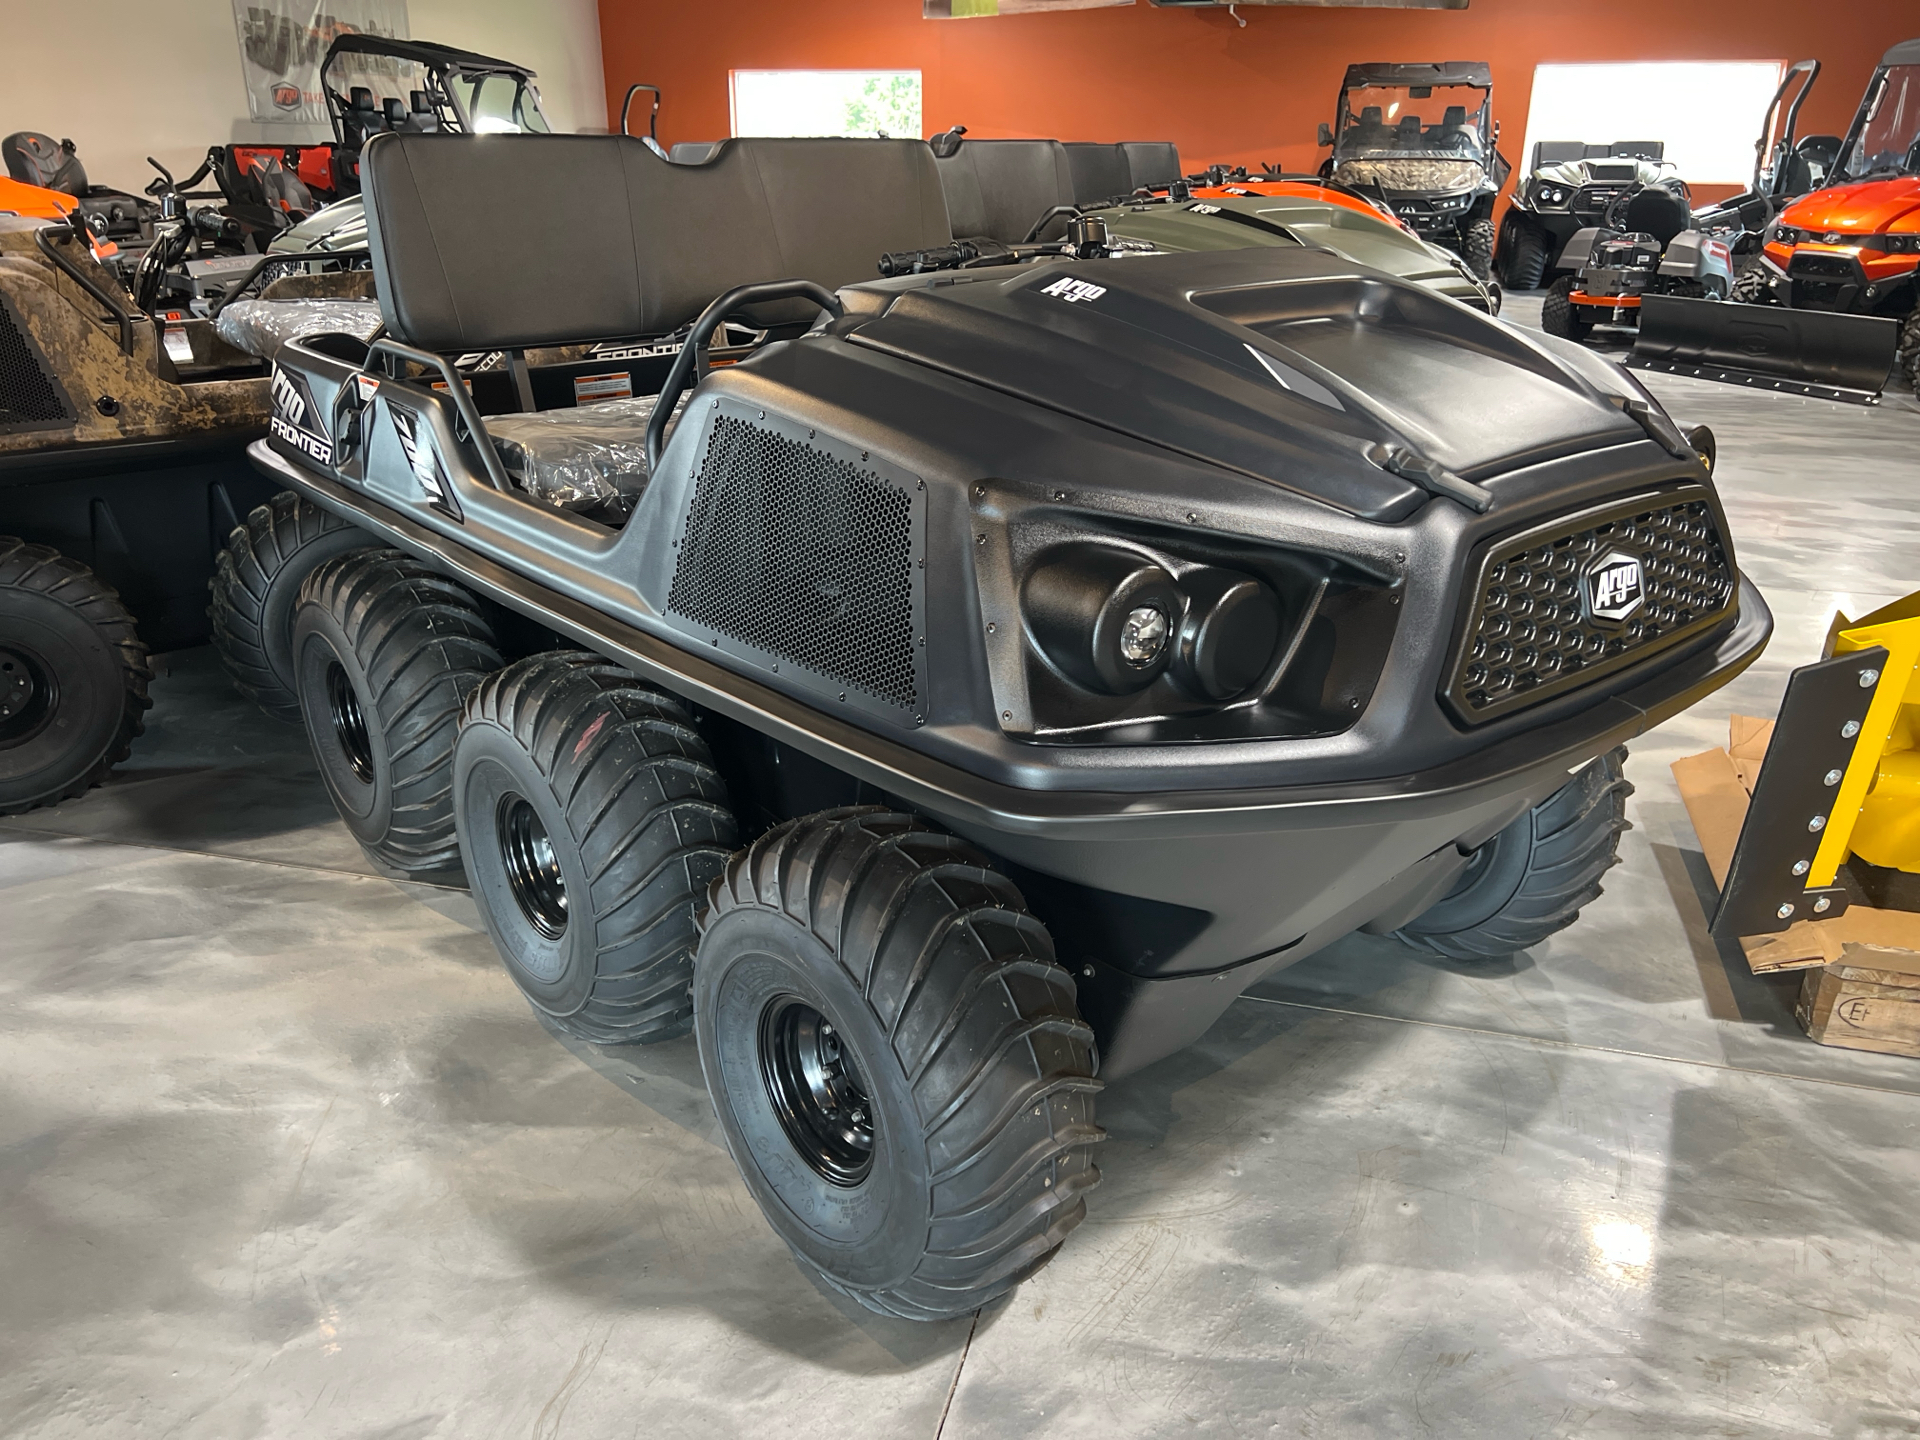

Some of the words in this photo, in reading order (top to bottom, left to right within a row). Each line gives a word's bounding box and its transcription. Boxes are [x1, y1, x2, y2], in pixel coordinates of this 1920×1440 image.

[302, 91, 325, 105] TAKE
[1040, 276, 1107, 303] Argo
[270, 416, 333, 466] FRONTIER
[1594, 563, 1638, 610] Argo
